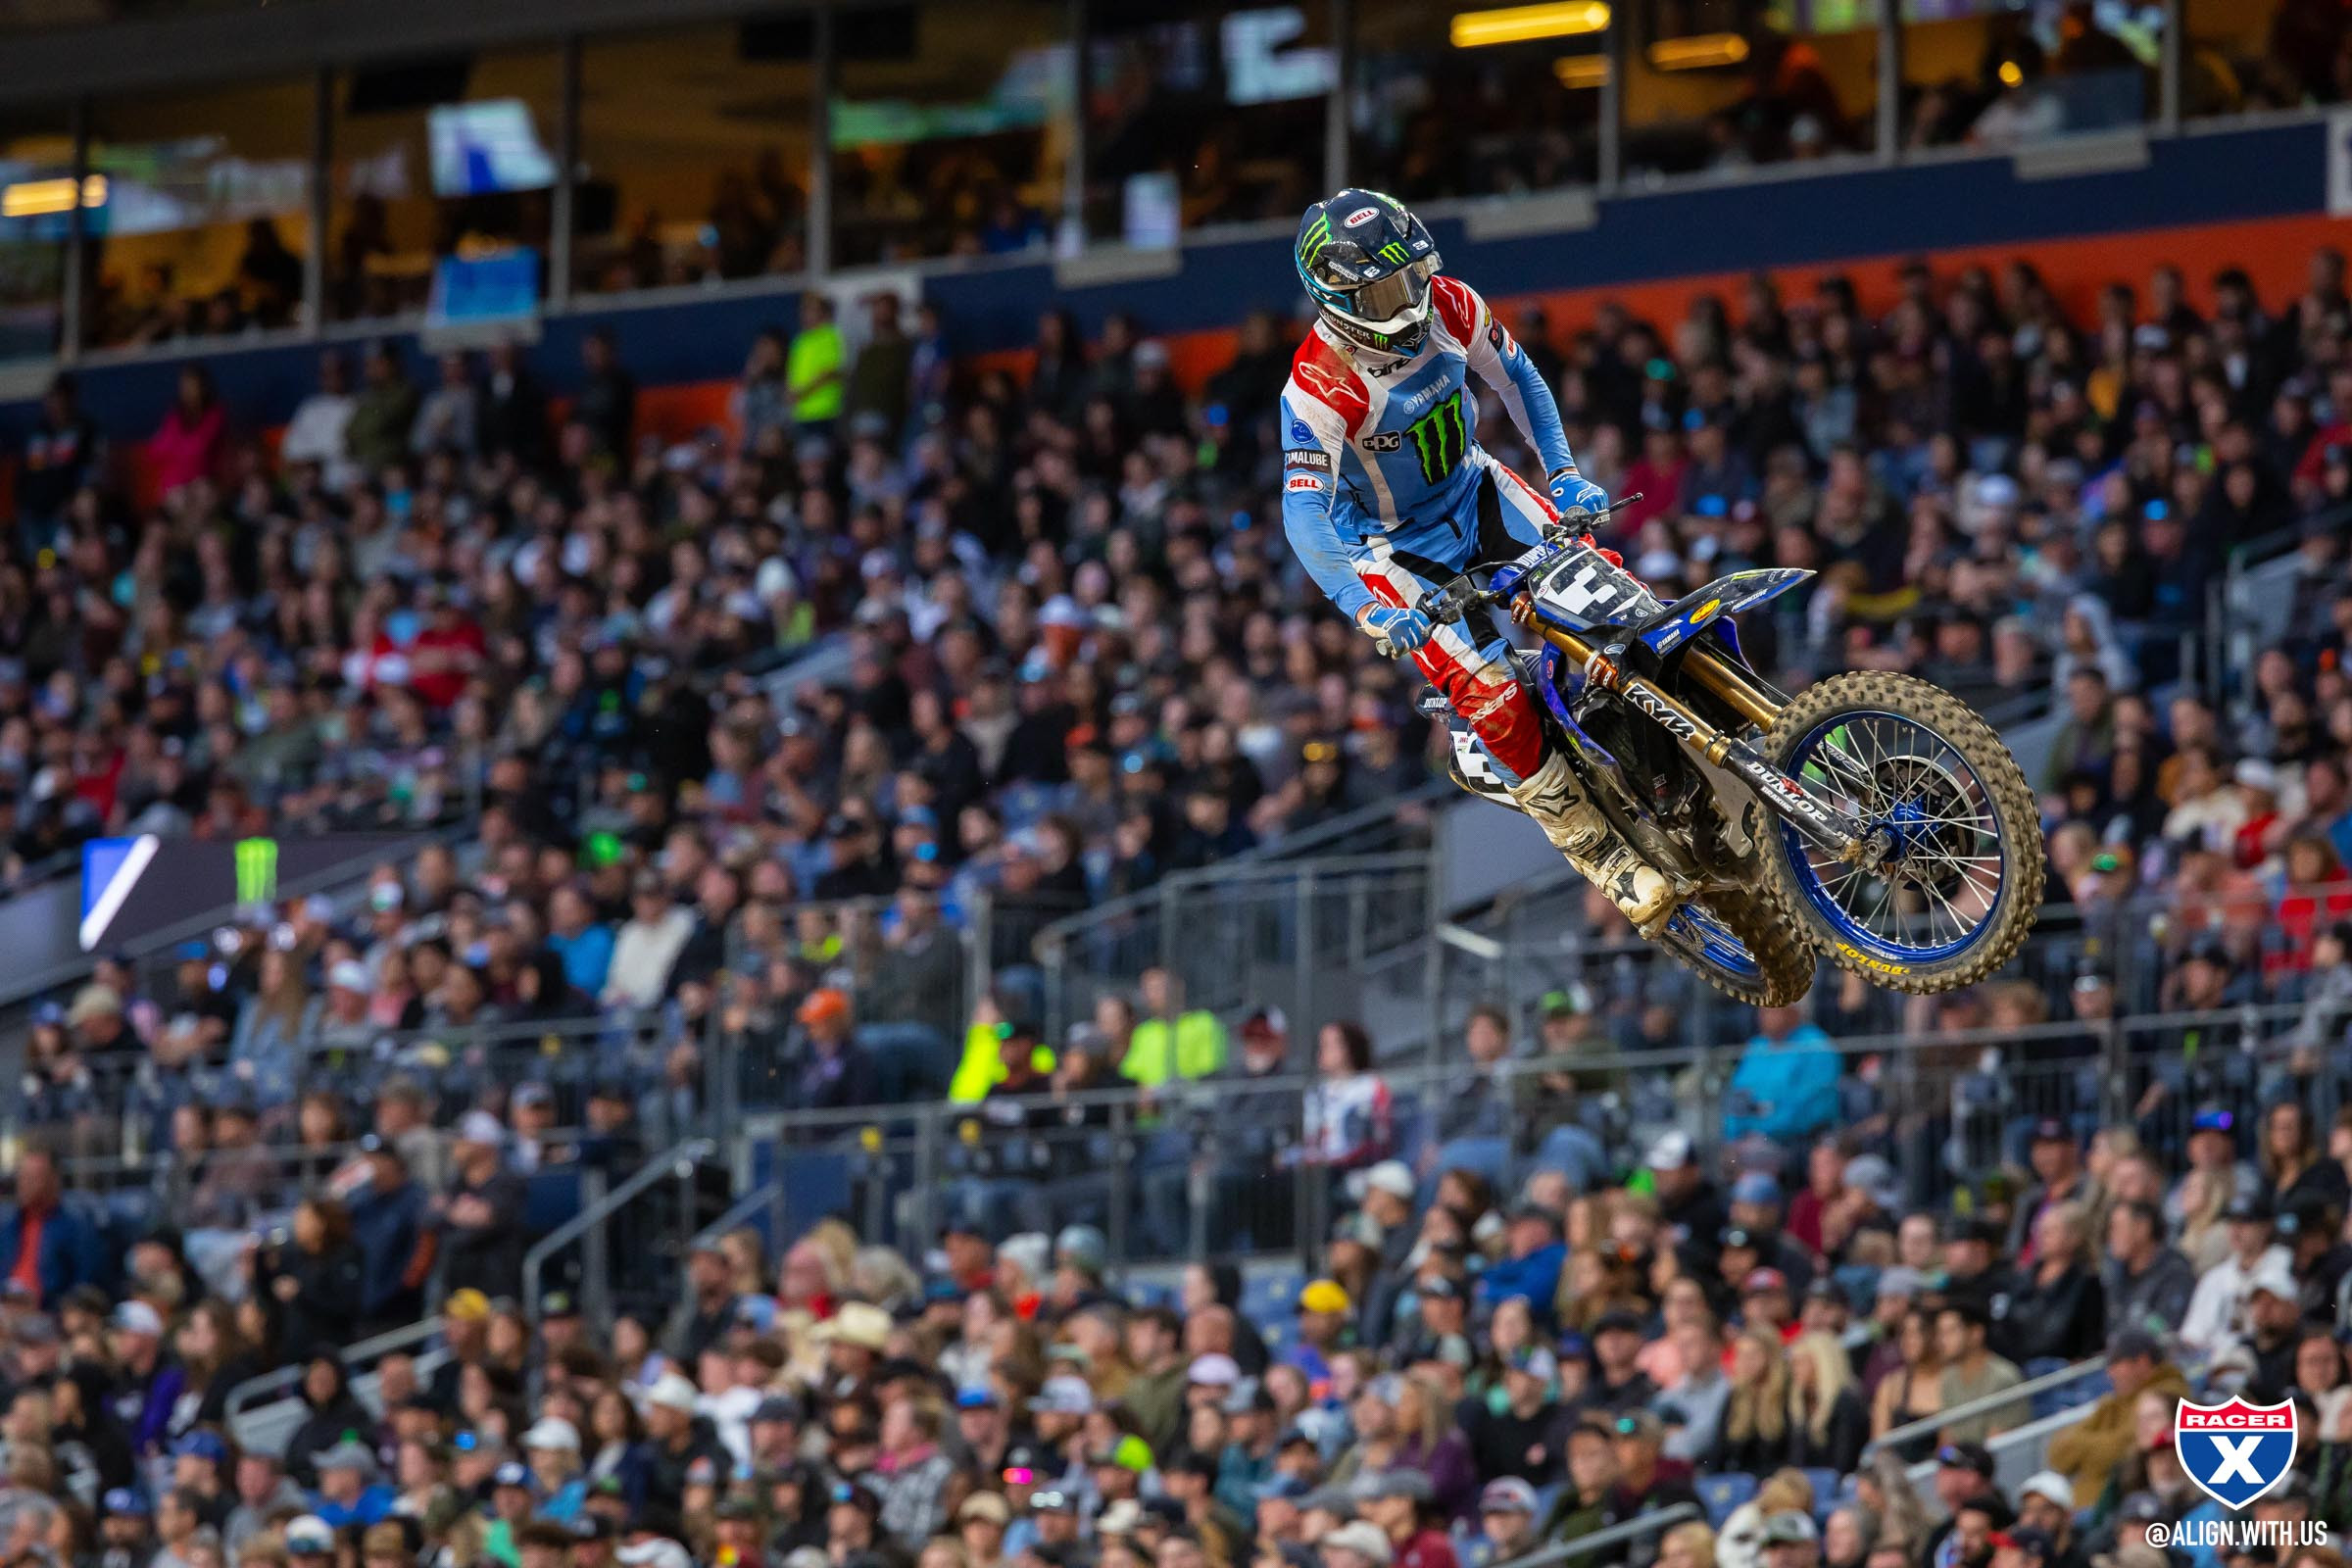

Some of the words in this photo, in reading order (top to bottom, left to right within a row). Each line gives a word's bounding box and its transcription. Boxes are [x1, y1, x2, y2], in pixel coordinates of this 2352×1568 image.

[1349, 210, 1375, 224] BELL
[1411, 374, 1450, 407] YAMAHA
[1290, 478, 1318, 489] BELL
[1549, 550, 1642, 625] 3
[1424, 698, 1448, 709] DUNLOP
[1623, 682, 1696, 741] KYB
[1760, 785, 1793, 812] BRAKING
[1836, 942, 1904, 976] DUNLOP
